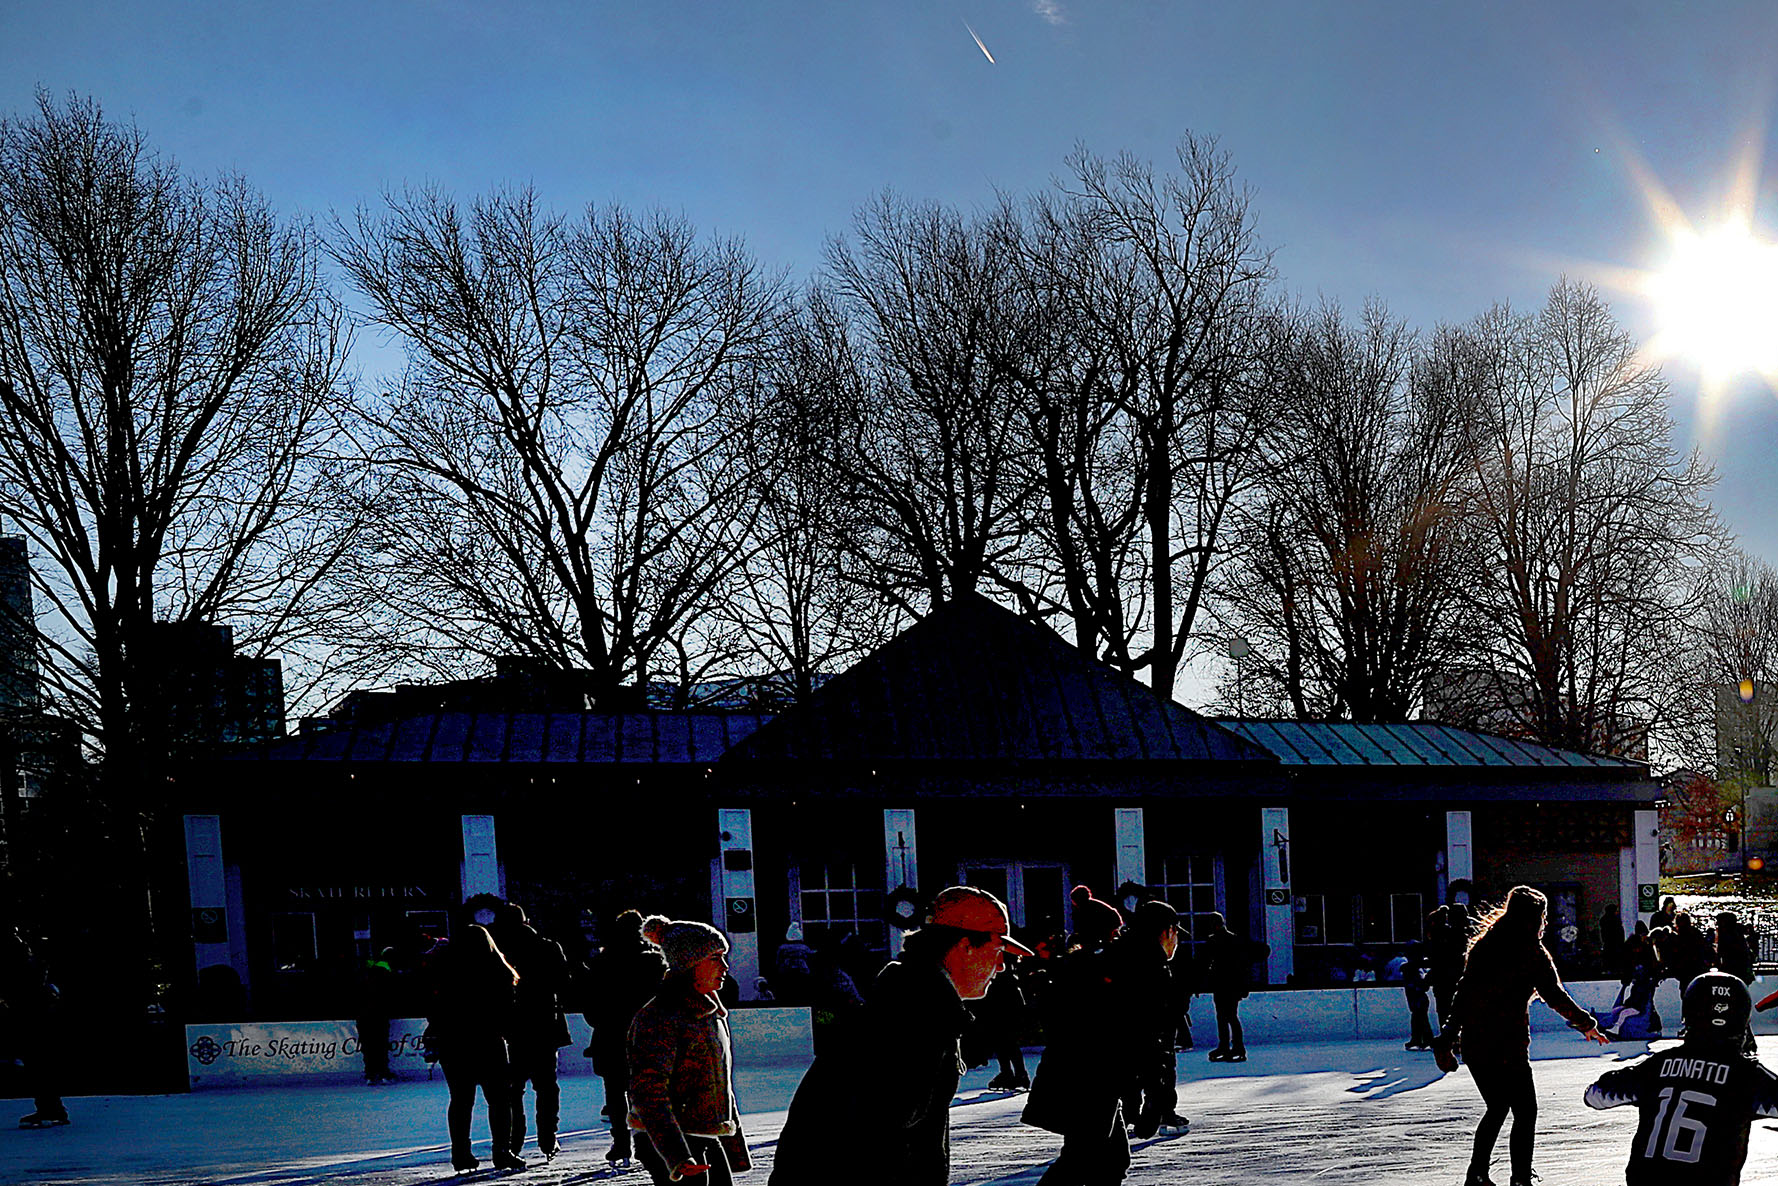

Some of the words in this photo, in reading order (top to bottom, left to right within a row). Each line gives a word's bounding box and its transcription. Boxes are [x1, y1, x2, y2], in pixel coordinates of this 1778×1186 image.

[1711, 986, 1731, 997] FOX
[223, 1038, 261, 1057] The
[265, 1037, 337, 1060] Skating
[391, 1034, 411, 1057] of
[1660, 1058, 1730, 1084] DONATO
[1644, 1087, 1717, 1163] 16
